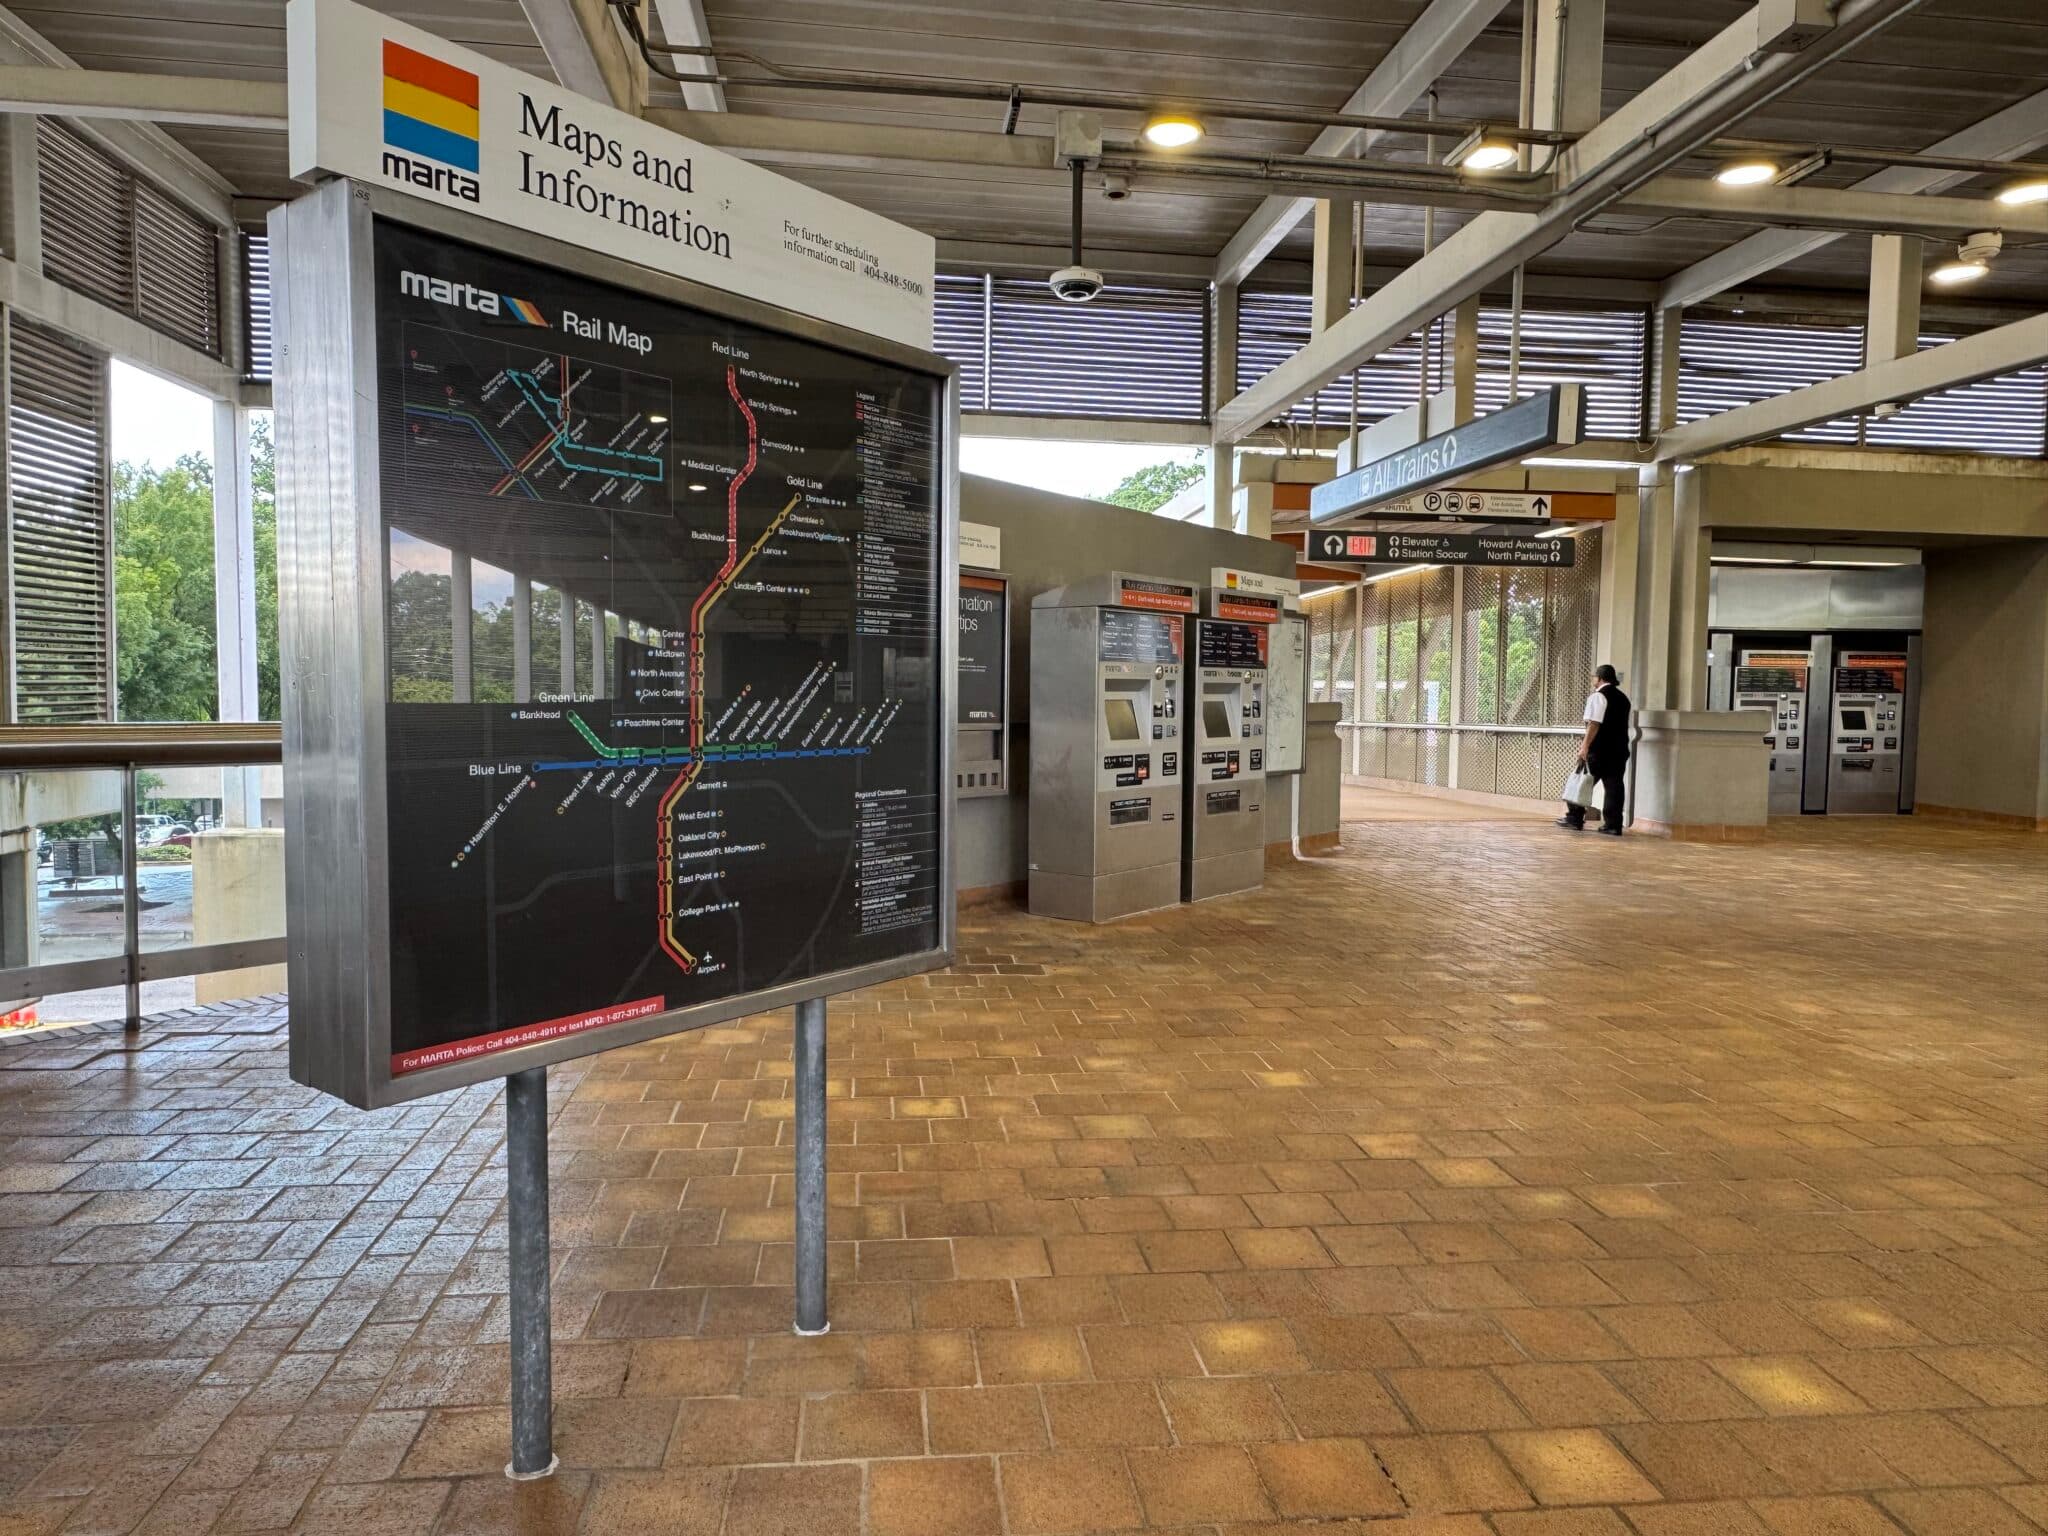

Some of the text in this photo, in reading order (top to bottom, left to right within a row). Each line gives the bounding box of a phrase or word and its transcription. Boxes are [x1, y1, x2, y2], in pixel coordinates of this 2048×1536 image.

[518, 92, 694, 193] Maps and
[382, 151, 480, 203] marta
[518, 151, 732, 259] Information
[784, 220, 879, 267] For further scheduling
[784, 239, 922, 295] information call 404-848-5000
[400, 270, 500, 316] marta
[562, 310, 652, 355] Rail Map
[712, 341, 750, 360] Red Line
[740, 367, 782, 386] North Springs
[748, 398, 792, 416] Sandy Springs
[761, 439, 794, 452] Dunwoody
[688, 459, 737, 475] Medical Center
[1372, 447, 1440, 496] All Trains
[786, 475, 823, 490] Gold Line
[691, 530, 725, 542] Buckhead
[1402, 537, 1438, 547] Elevator
[763, 547, 781, 556] Lenox
[1352, 538, 1371, 554] EXIT
[1479, 540, 1549, 550] Howard Avenue
[1402, 549, 1468, 559] Station Soccer
[1487, 551, 1547, 563] North Parking
[766, 584, 786, 593] Center
[959, 595, 992, 612] mation
[662, 630, 685, 638] Center
[655, 649, 685, 657] Midtown
[638, 669, 685, 678] North Avenue
[539, 692, 595, 704] Green Line
[642, 689, 685, 697] Civic Center
[519, 710, 561, 720] Bankhead
[624, 718, 685, 727] Peachtree Center
[729, 700, 761, 741] Georgia State
[705, 707, 734, 742] Five Points
[469, 763, 522, 776] Blue Line
[561, 770, 594, 809] West Lake
[610, 768, 637, 800] Vine City
[626, 766, 660, 808] SEC District
[697, 781, 721, 790] Garnett
[469, 807, 500, 847] Hamilton
[505, 774, 531, 805] Holmes
[678, 811, 710, 821] West End
[678, 831, 720, 842] Oakland City
[678, 872, 712, 884] East Point
[678, 903, 720, 918] College Park
[697, 963, 720, 975] Airport
[403, 1057, 418, 1068] For
[420, 1050, 454, 1065] MARTA
[456, 1044, 484, 1057] Police:
[486, 1038, 503, 1049] Call
[569, 1020, 583, 1031] text
[585, 1015, 605, 1028] MPD:
